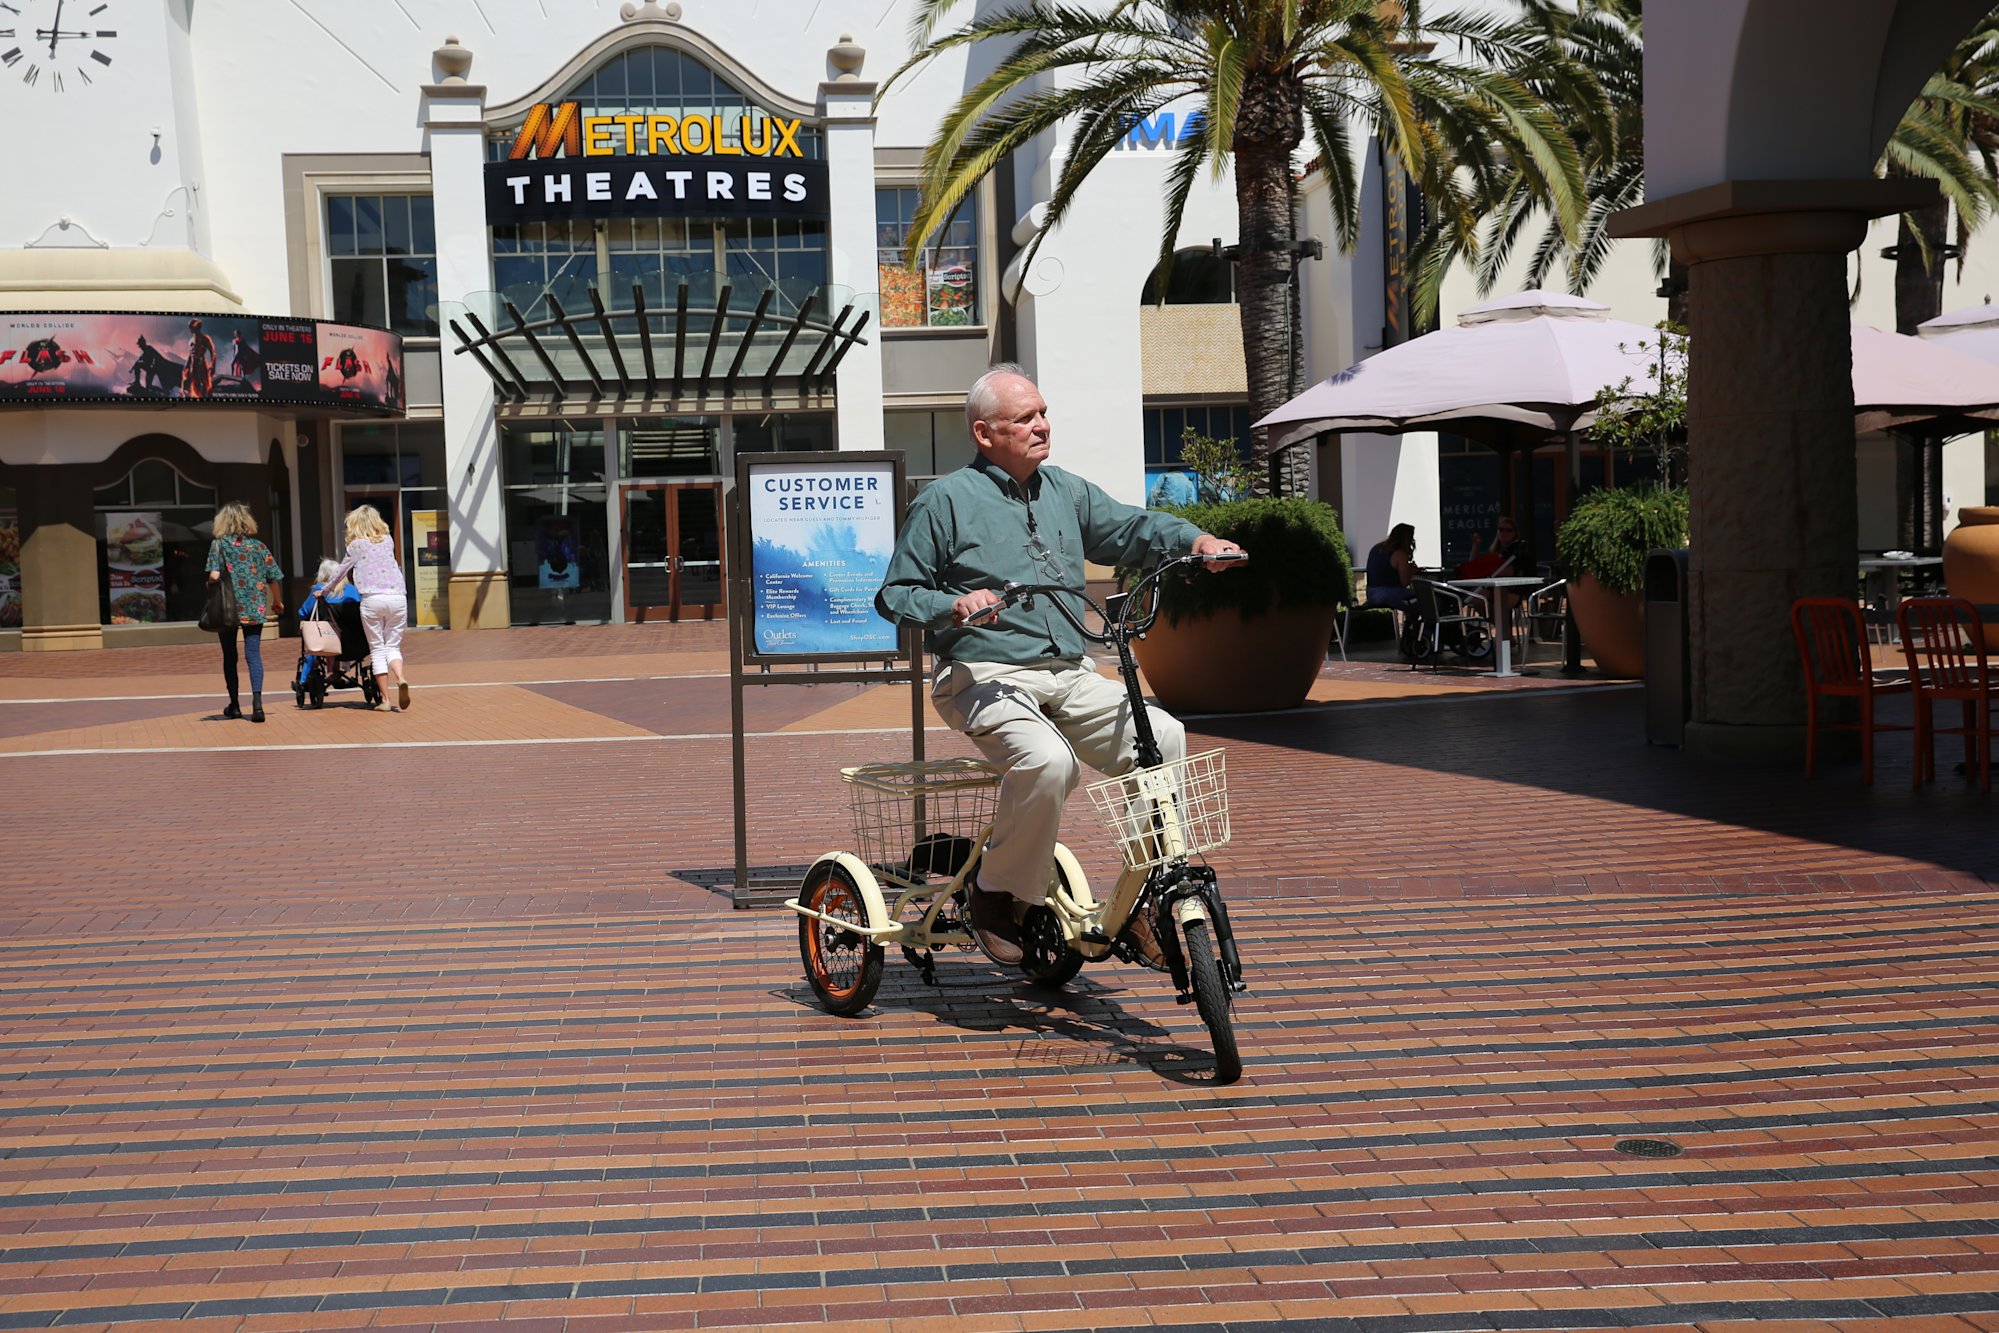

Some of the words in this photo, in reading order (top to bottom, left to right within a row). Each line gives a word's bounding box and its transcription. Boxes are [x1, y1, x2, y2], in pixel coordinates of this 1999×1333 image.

[508, 101, 804, 160] METROLUX
[507, 170, 807, 205] THEATRES
[285, 325, 311, 333] THEATERS
[263, 332, 295, 343] JUNE
[301, 333, 313, 344] 16
[0, 349, 94, 366] FLASH
[265, 362, 300, 373] TICKETS
[301, 364, 313, 374] ON
[321, 357, 372, 375] FLASH
[268, 371, 290, 380] SALE
[291, 372, 312, 382] NOW
[765, 477, 878, 493] CUSTOMER
[779, 496, 864, 511] SERVICE
[1443, 502, 1500, 515] MERICA
[1447, 518, 1491, 529] EAGLE
[802, 560, 846, 568] AMENITIES
[764, 629, 797, 640] Outlets
